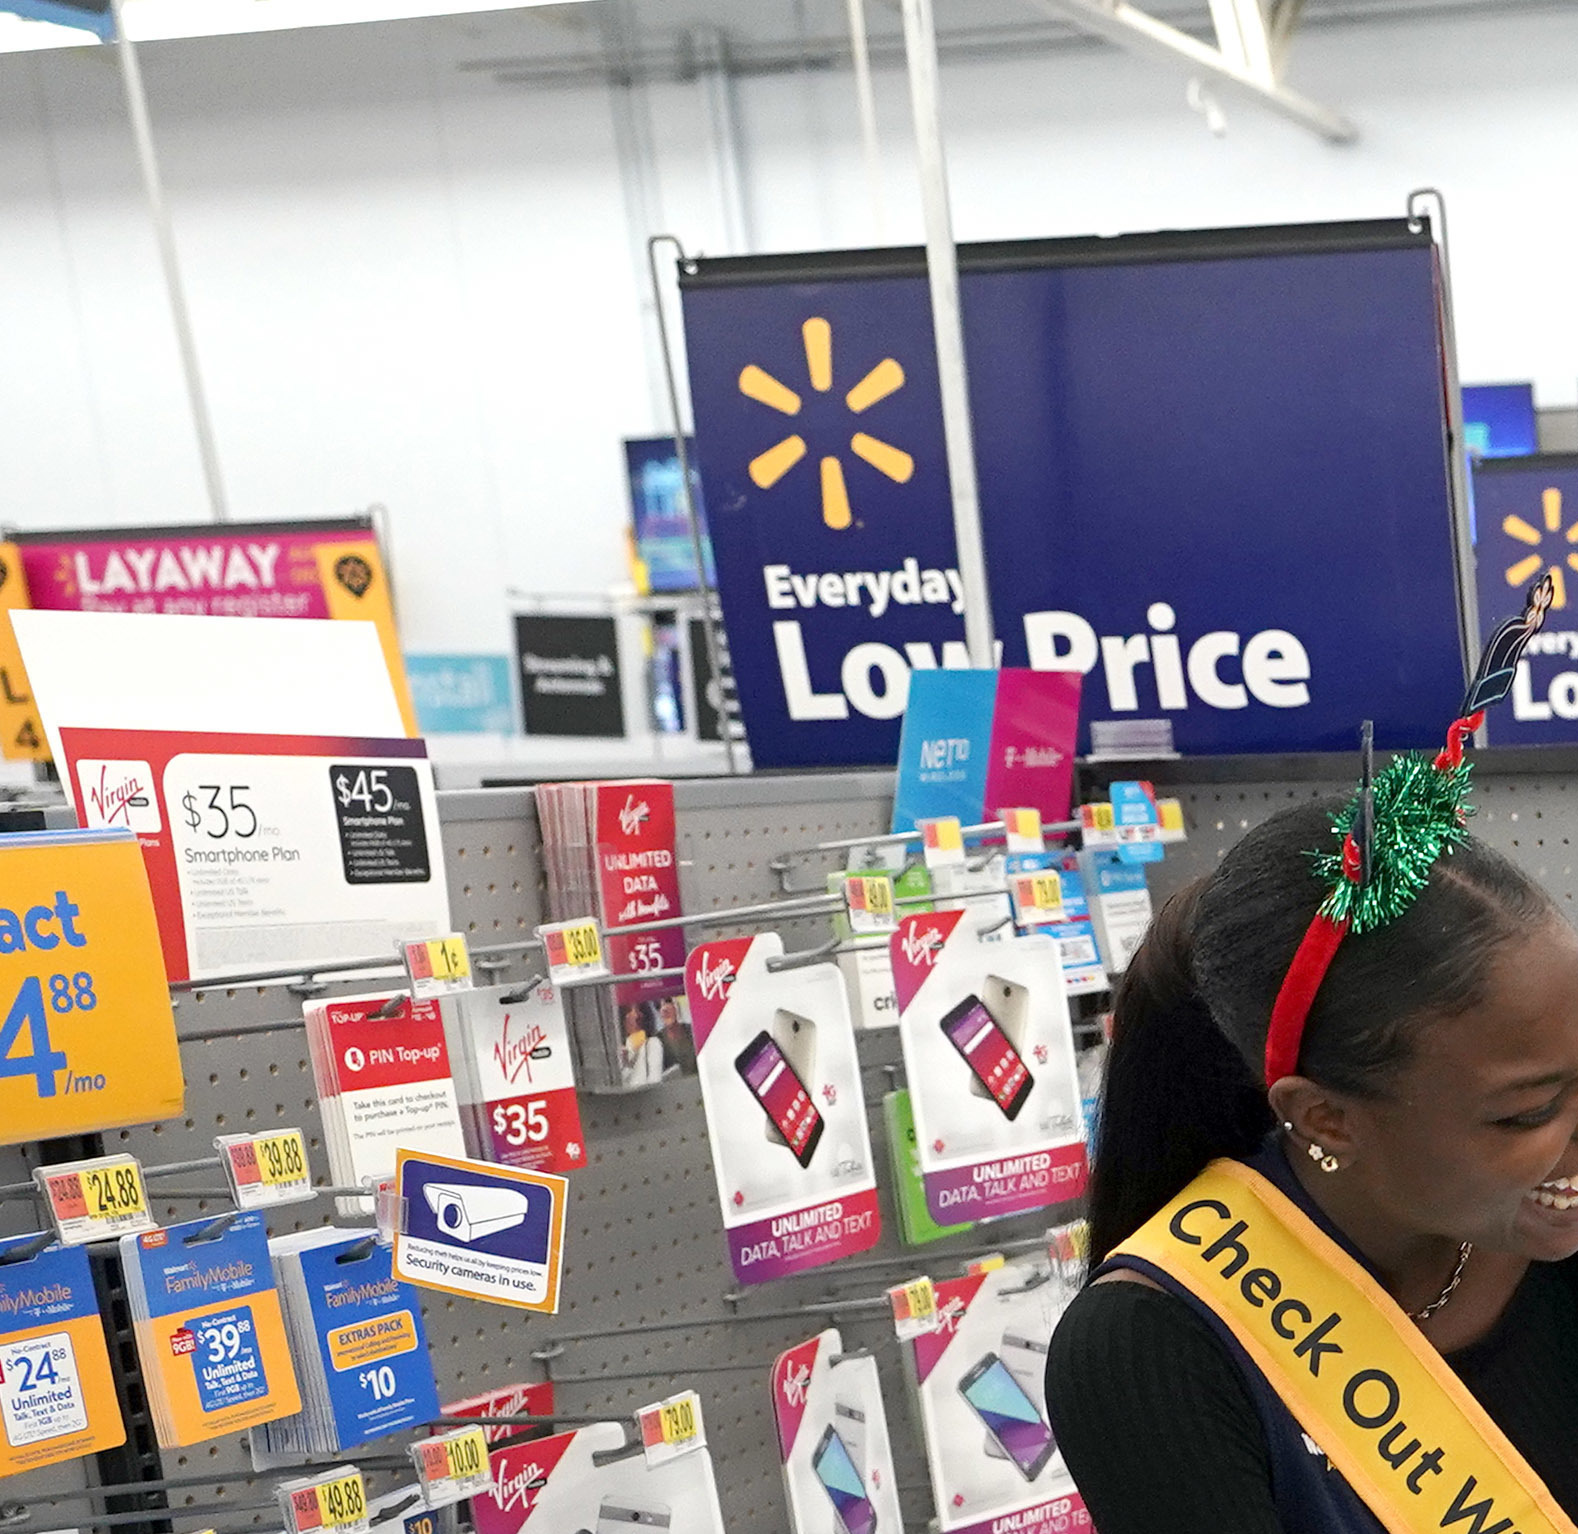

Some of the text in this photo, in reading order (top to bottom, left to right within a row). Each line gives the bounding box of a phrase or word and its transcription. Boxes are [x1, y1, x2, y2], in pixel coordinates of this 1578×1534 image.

[75, 543, 279, 593] LAYAWAY
[764, 557, 966, 616] Everyday
[1024, 603, 1311, 712] Price
[1, 669, 28, 704] L
[16, 720, 40, 749] 4
[91, 765, 144, 825] Virgin
[335, 770, 393, 812] $45
[182, 785, 257, 838] $35
[342, 815, 404, 827] Smartphone Plan
[185, 846, 300, 868] Smartphone Plan
[605, 849, 671, 870] UNLIMITED
[623, 876, 657, 893] DATA
[628, 943, 662, 973] $35
[696, 955, 737, 1001] Virgin
[331, 1012, 366, 1024] TOP-UP
[369, 1045, 393, 1065] PIN
[494, 1014, 546, 1084] Virgin
[353, 1097, 371, 1110] Take
[372, 1095, 386, 1107] this
[404, 1096, 414, 1104] to
[415, 1091, 447, 1103] checkout
[353, 1107, 398, 1122] to purchase
[494, 1100, 548, 1145] $35
[262, 1140, 303, 1179] $39.88
[89, 1169, 139, 1211] $24.88
[771, 1202, 843, 1238] UNLIMITED
[782, 1231, 811, 1253] TALK
[813, 1223, 842, 1247] AND
[843, 1212, 872, 1238] TEXT
[165, 1260, 253, 1294] FamilyMobile
[406, 1254, 536, 1292] Security cameras in use.
[511, 1267, 527, 1277] prices
[201, 1315, 236, 1329] No-Contract
[339, 1324, 376, 1346] EXTRAS
[377, 1318, 403, 1336] PACK
[11, 1342, 51, 1355] No-Contract
[173, 1340, 195, 1354] 9GB!
[1169, 1199, 1344, 1376] Check
[1342, 1367, 1445, 1495] Out
[202, 1357, 256, 1381] Unlimited
[360, 1366, 396, 1400] $10
[11, 1387, 72, 1411] Unlimited
[32, 1407, 48, 1418] Text
[57, 1402, 75, 1413] Data
[324, 1481, 363, 1519] $49.88
[489, 1459, 544, 1513] Virgin
